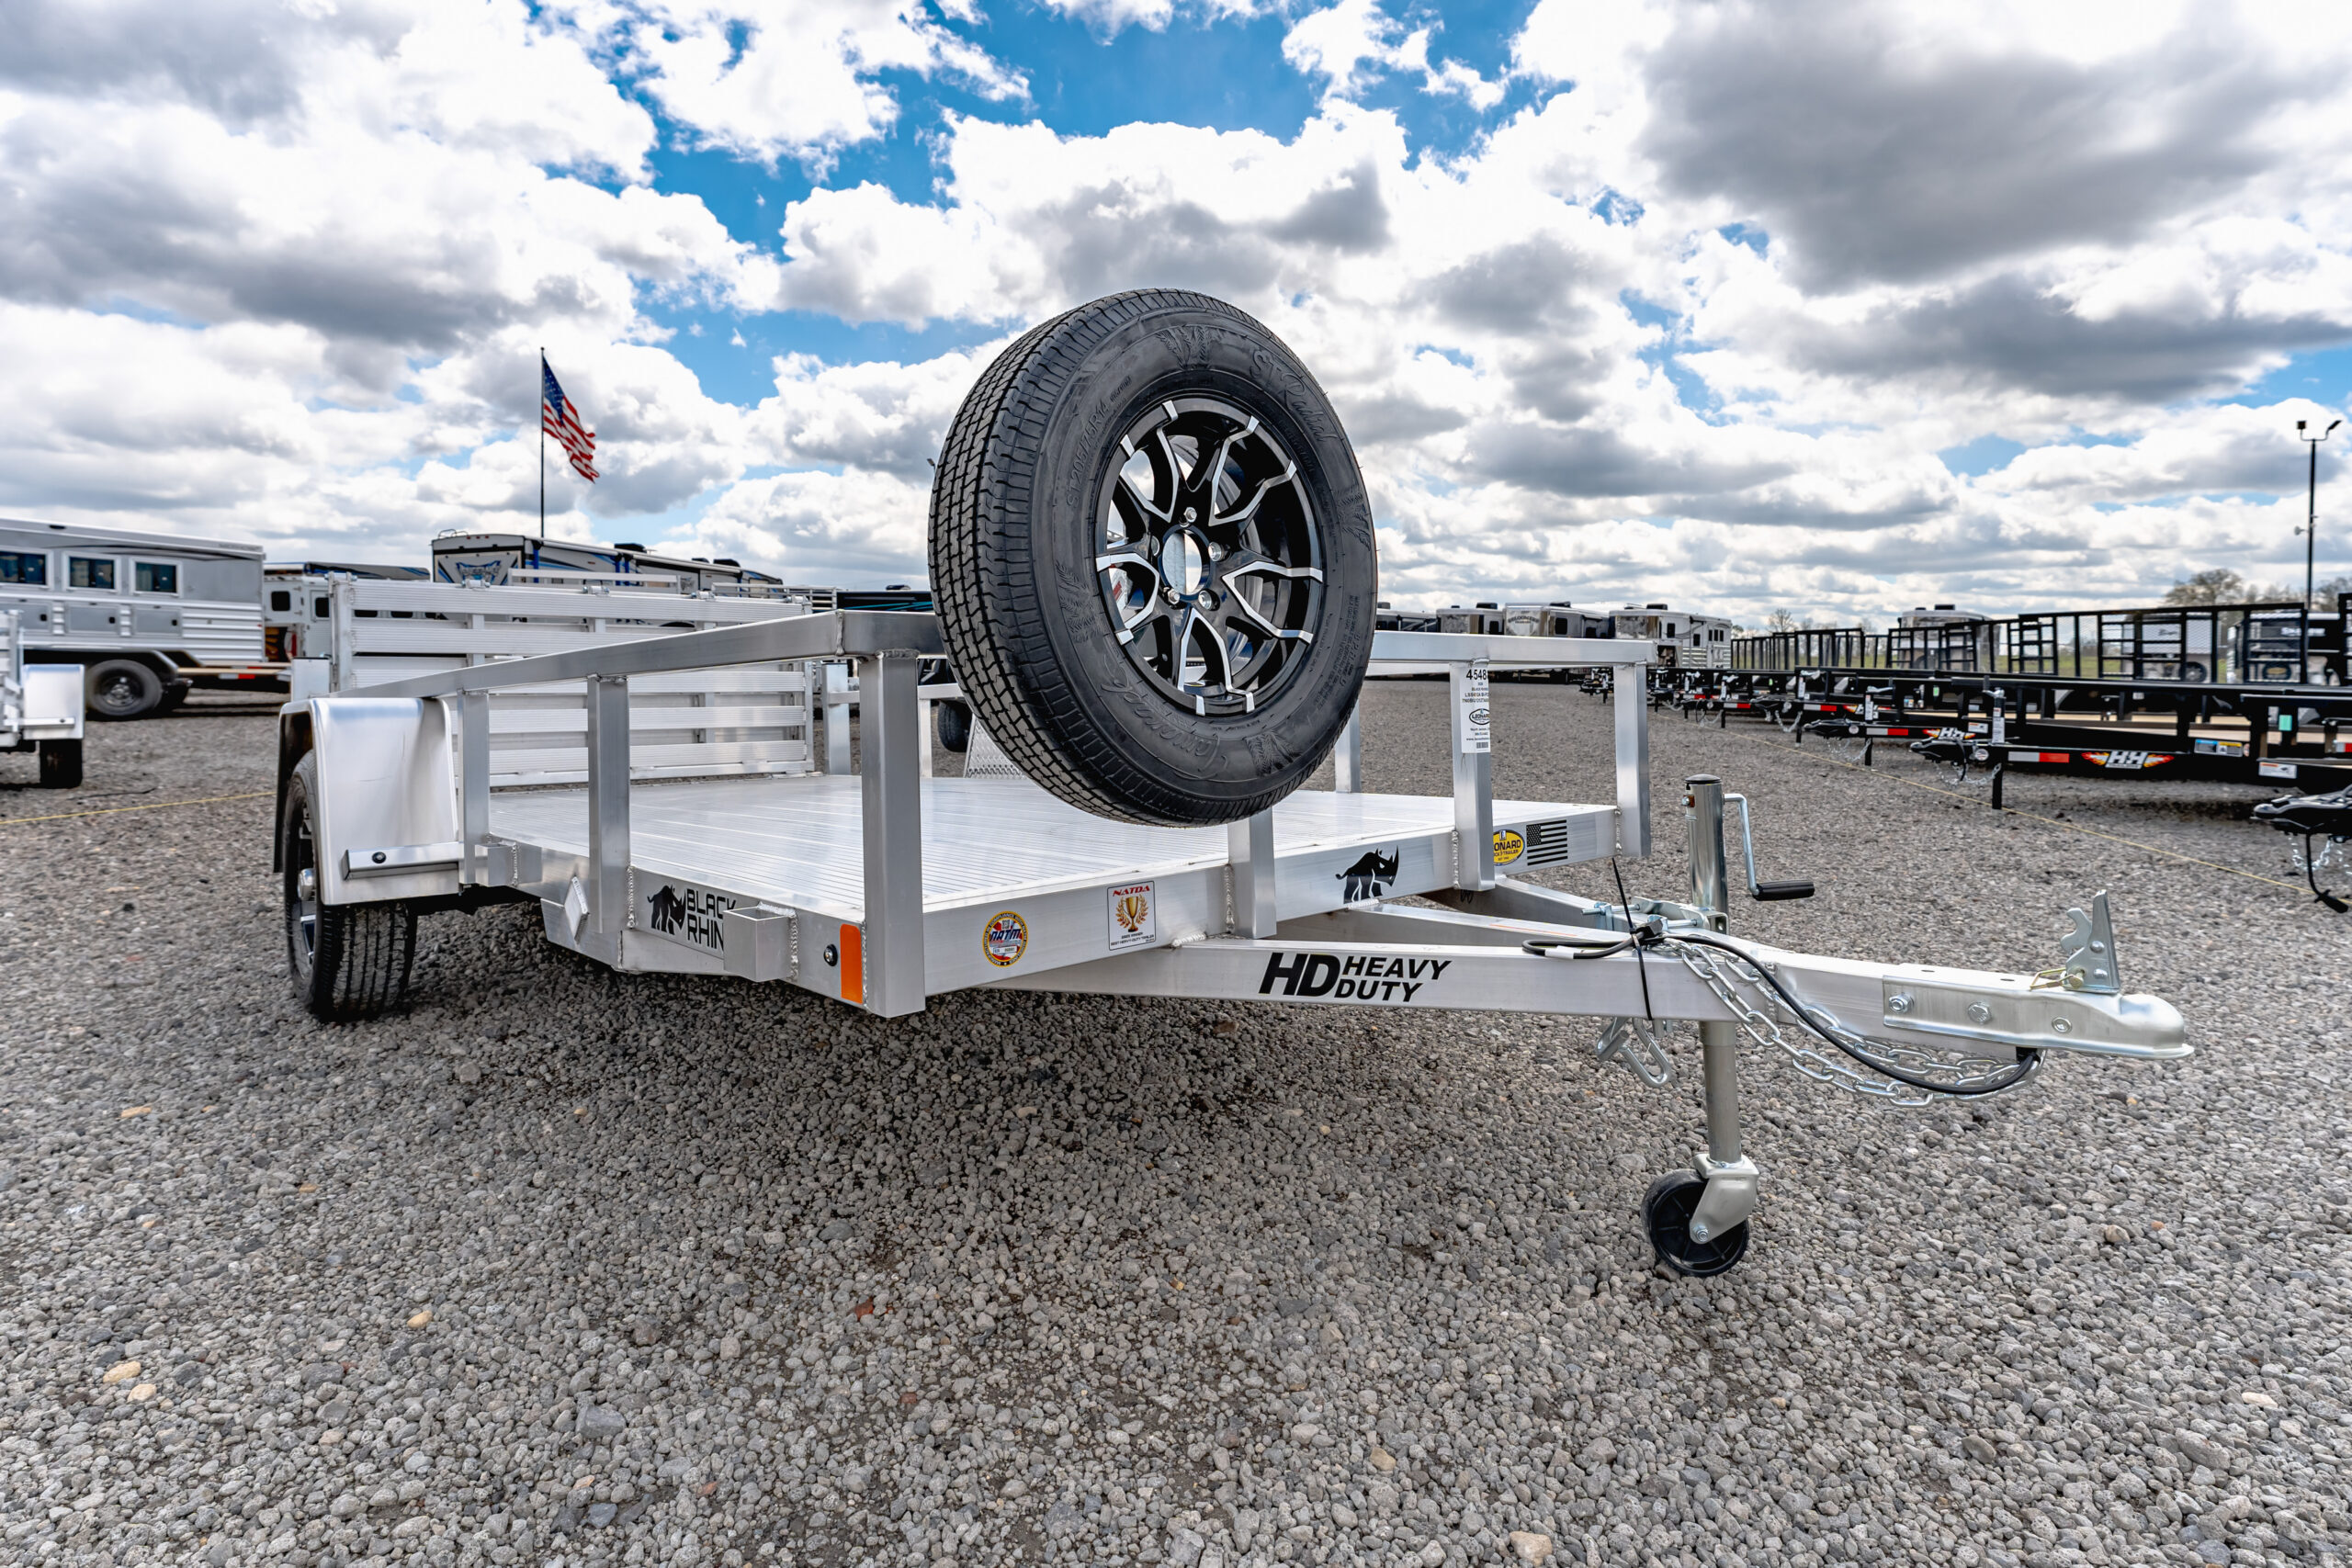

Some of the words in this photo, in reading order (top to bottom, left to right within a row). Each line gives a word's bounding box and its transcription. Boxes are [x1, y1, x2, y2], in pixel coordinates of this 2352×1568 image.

[1277, 372, 1340, 442] Radial
[1494, 840, 1521, 851] ONARD
[1113, 886, 1150, 897] NATDA
[687, 913, 724, 952] RHIN
[1259, 953, 1341, 997] HD
[1342, 955, 1452, 980] HEAVY
[1334, 978, 1423, 1002] DUTY
